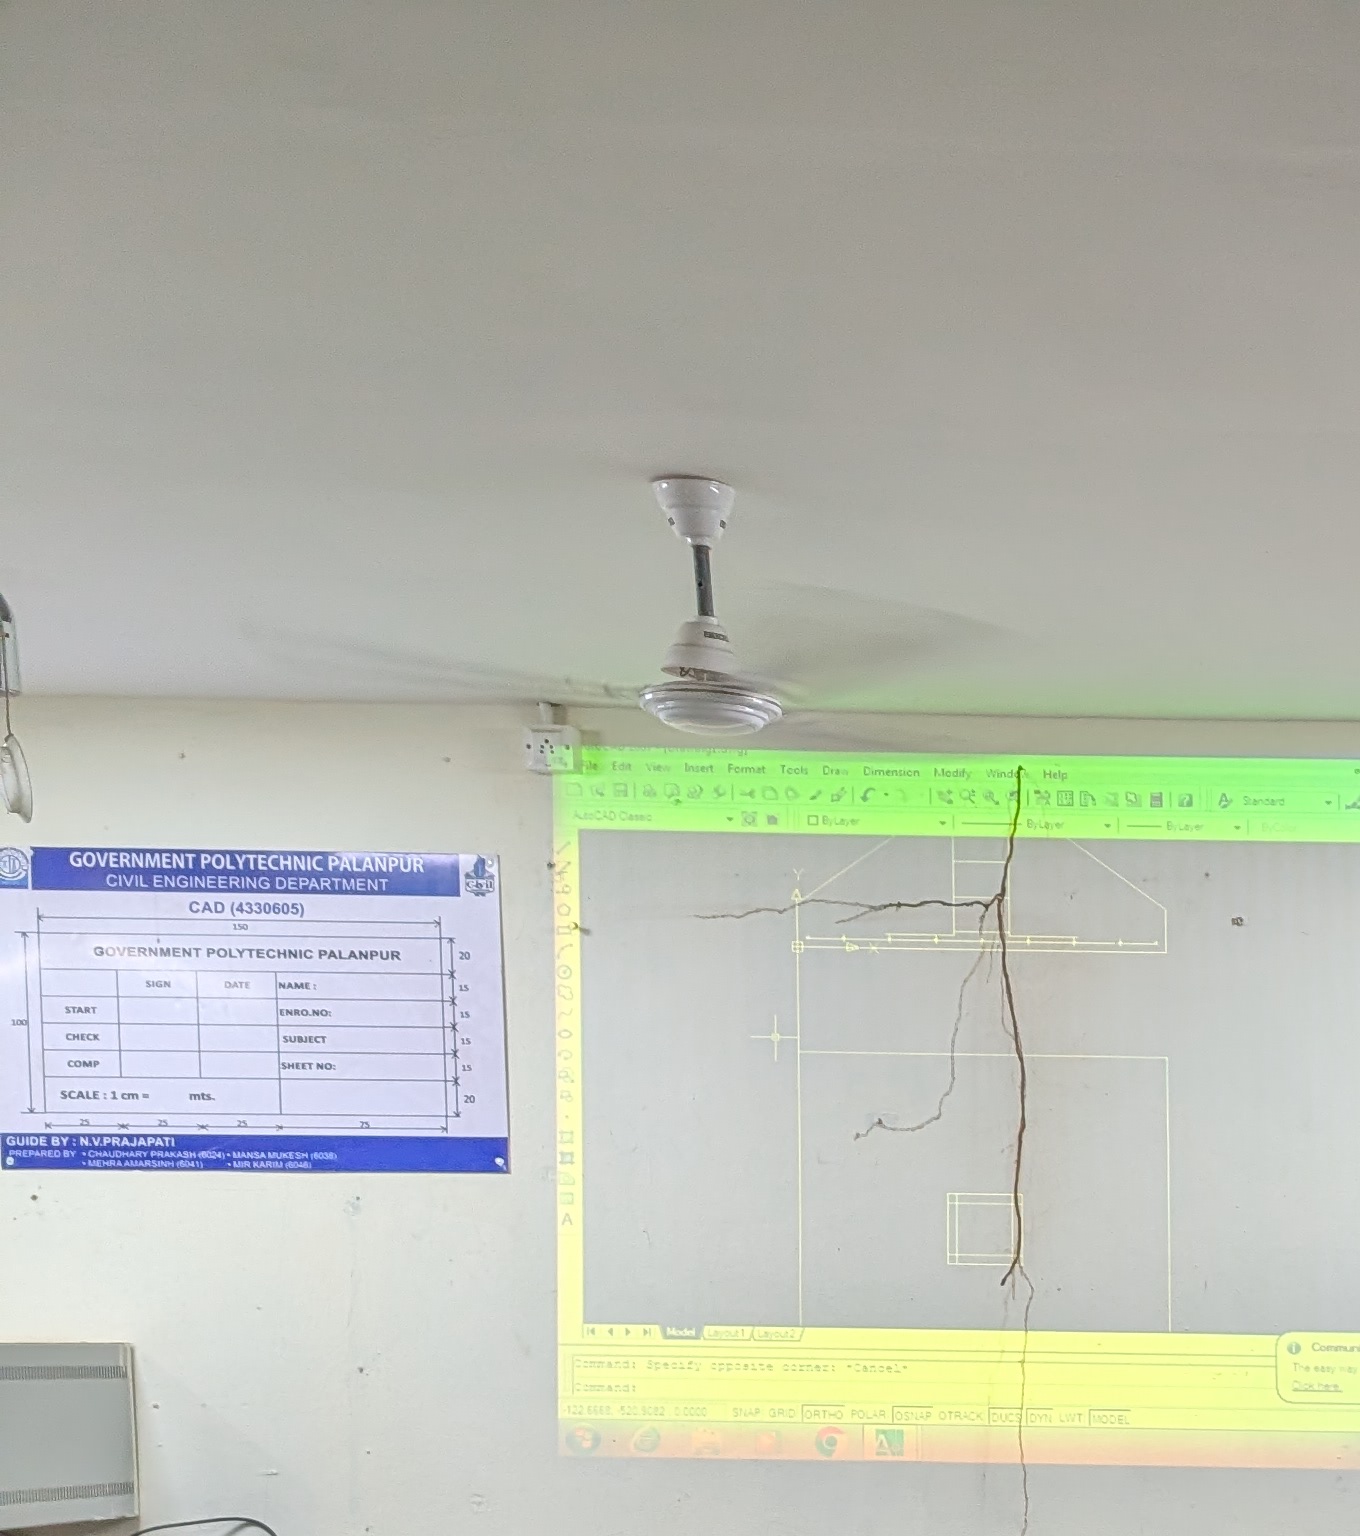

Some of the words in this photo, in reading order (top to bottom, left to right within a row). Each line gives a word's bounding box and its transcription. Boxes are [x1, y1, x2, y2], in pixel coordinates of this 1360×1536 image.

[611, 761, 632, 772] Edit
[684, 762, 714, 774] Insert
[727, 763, 767, 775] Format
[780, 763, 809, 776] Tools
[862, 766, 920, 778] Dimension
[933, 767, 972, 780] Modify
[1042, 769, 1068, 781] Help
[69, 851, 196, 869] GOVERNMENT
[200, 853, 323, 871] POLYTECHNIC
[328, 855, 425, 873] PALANPUR
[106, 874, 149, 888] CIVIL
[153, 875, 270, 889] ENGINEERING
[275, 877, 389, 892] DEPARTMENT
[188, 900, 225, 914] CAD
[230, 901, 305, 918] (4330605)
[232, 923, 249, 931] 150
[93, 946, 202, 958] GOVERNMENT
[206, 947, 313, 960] POLYTECHNIC
[320, 949, 402, 961] PALANPUR
[458, 951, 471, 960] 20
[145, 980, 171, 989] SIGN
[224, 980, 251, 990] DATE
[278, 981, 311, 991] NAME
[458, 983, 469, 992] 15
[64, 1005, 98, 1015] START
[460, 1010, 470, 1019] 15
[65, 1032, 101, 1041] CHECK
[282, 1034, 327, 1045] SUBJECT
[461, 1037, 472, 1046] 15
[67, 1059, 100, 1069] COMP
[281, 1060, 313, 1071] SHEET
[316, 1061, 337, 1072] NO:
[462, 1063, 473, 1073] 15
[59, 1089, 100, 1101] SCALE
[120, 1092, 140, 1100] cm
[188, 1091, 216, 1101] mts.
[463, 1094, 476, 1104] 20
[6, 1135, 47, 1147] GUIDE
[51, 1136, 68, 1147] BY
[79, 1136, 176, 1148] N.V.PRAJAPATI
[8, 1149, 61, 1158] PREPARED
[62, 1149, 77, 1158] BY
[87, 1150, 148, 1159] CHAUDHARY
[150, 1150, 197, 1159] PRAKASH
[666, 1327, 696, 1337] Model
[707, 1328, 746, 1339] Layout1
[757, 1329, 797, 1340] Layout2
